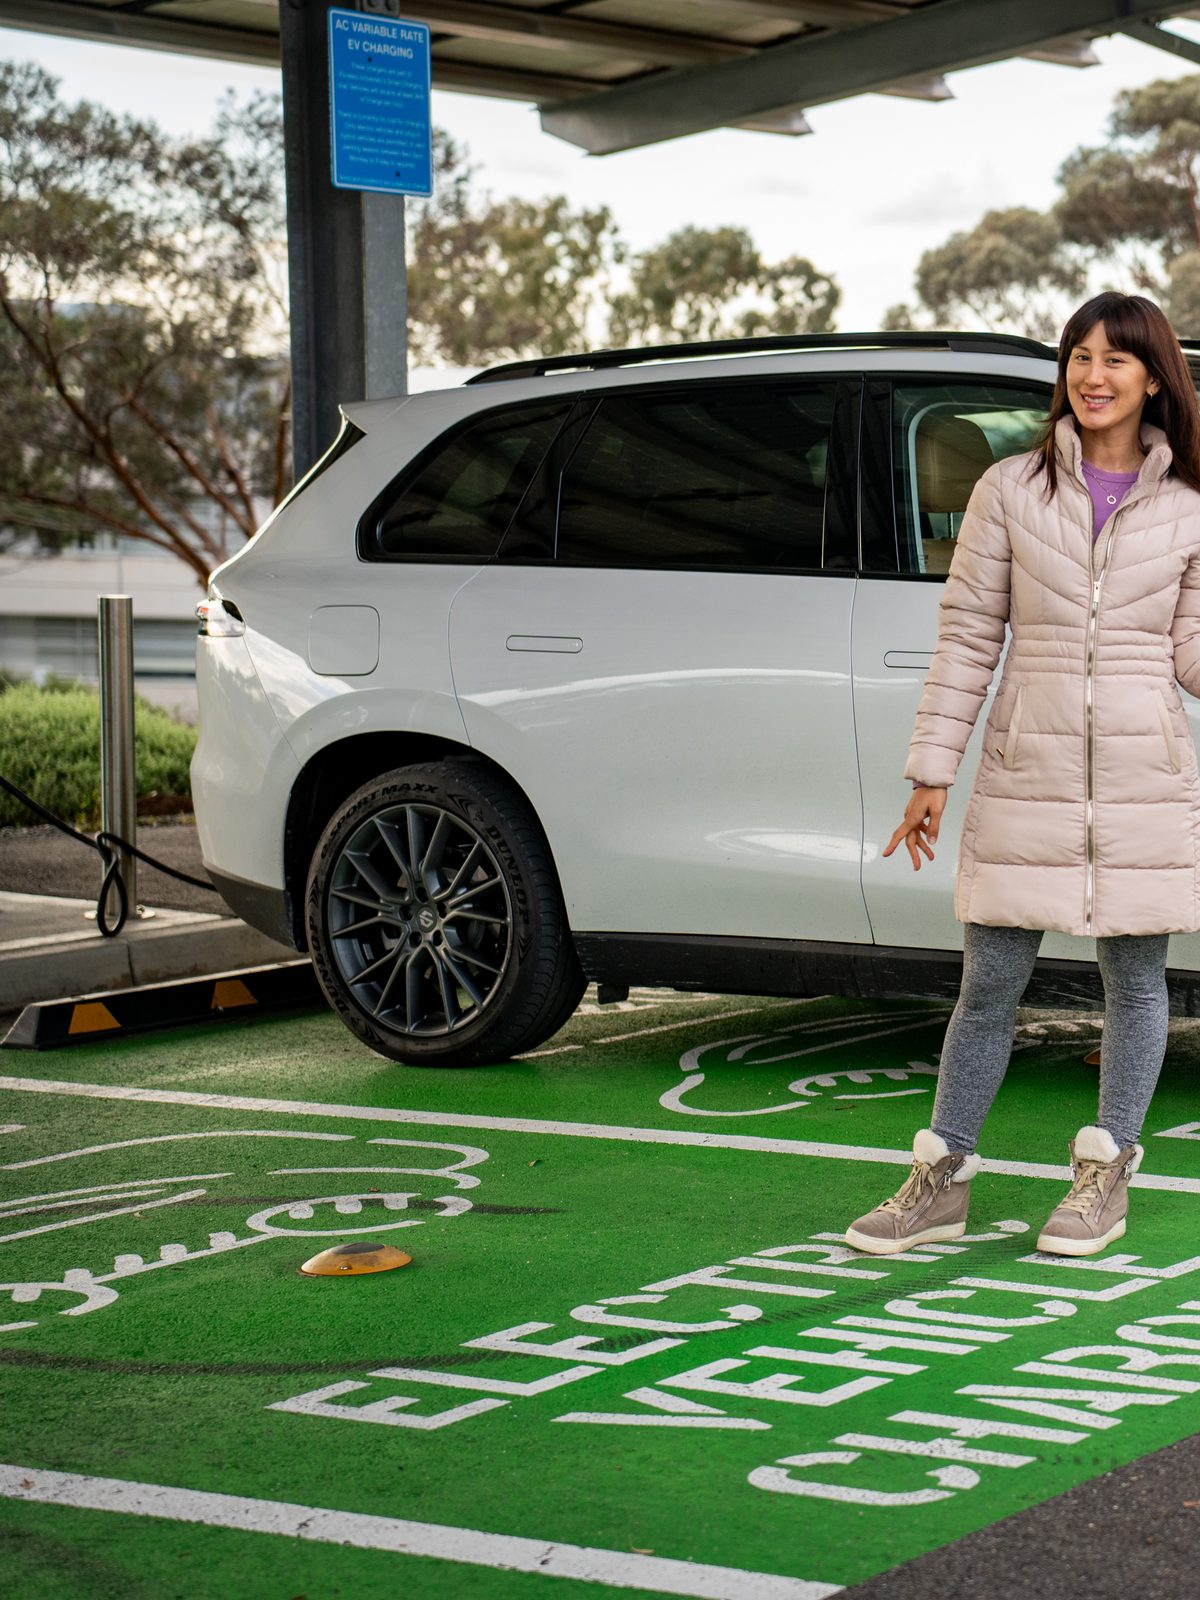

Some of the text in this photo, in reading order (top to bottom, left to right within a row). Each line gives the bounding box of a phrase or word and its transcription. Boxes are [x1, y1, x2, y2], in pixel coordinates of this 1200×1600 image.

[335, 19, 424, 43] AC VARIABLE RATE
[348, 39, 413, 59] EV CHARGING
[486, 824, 530, 924] DUNLOP
[309, 915, 351, 1017] DUNLOP
